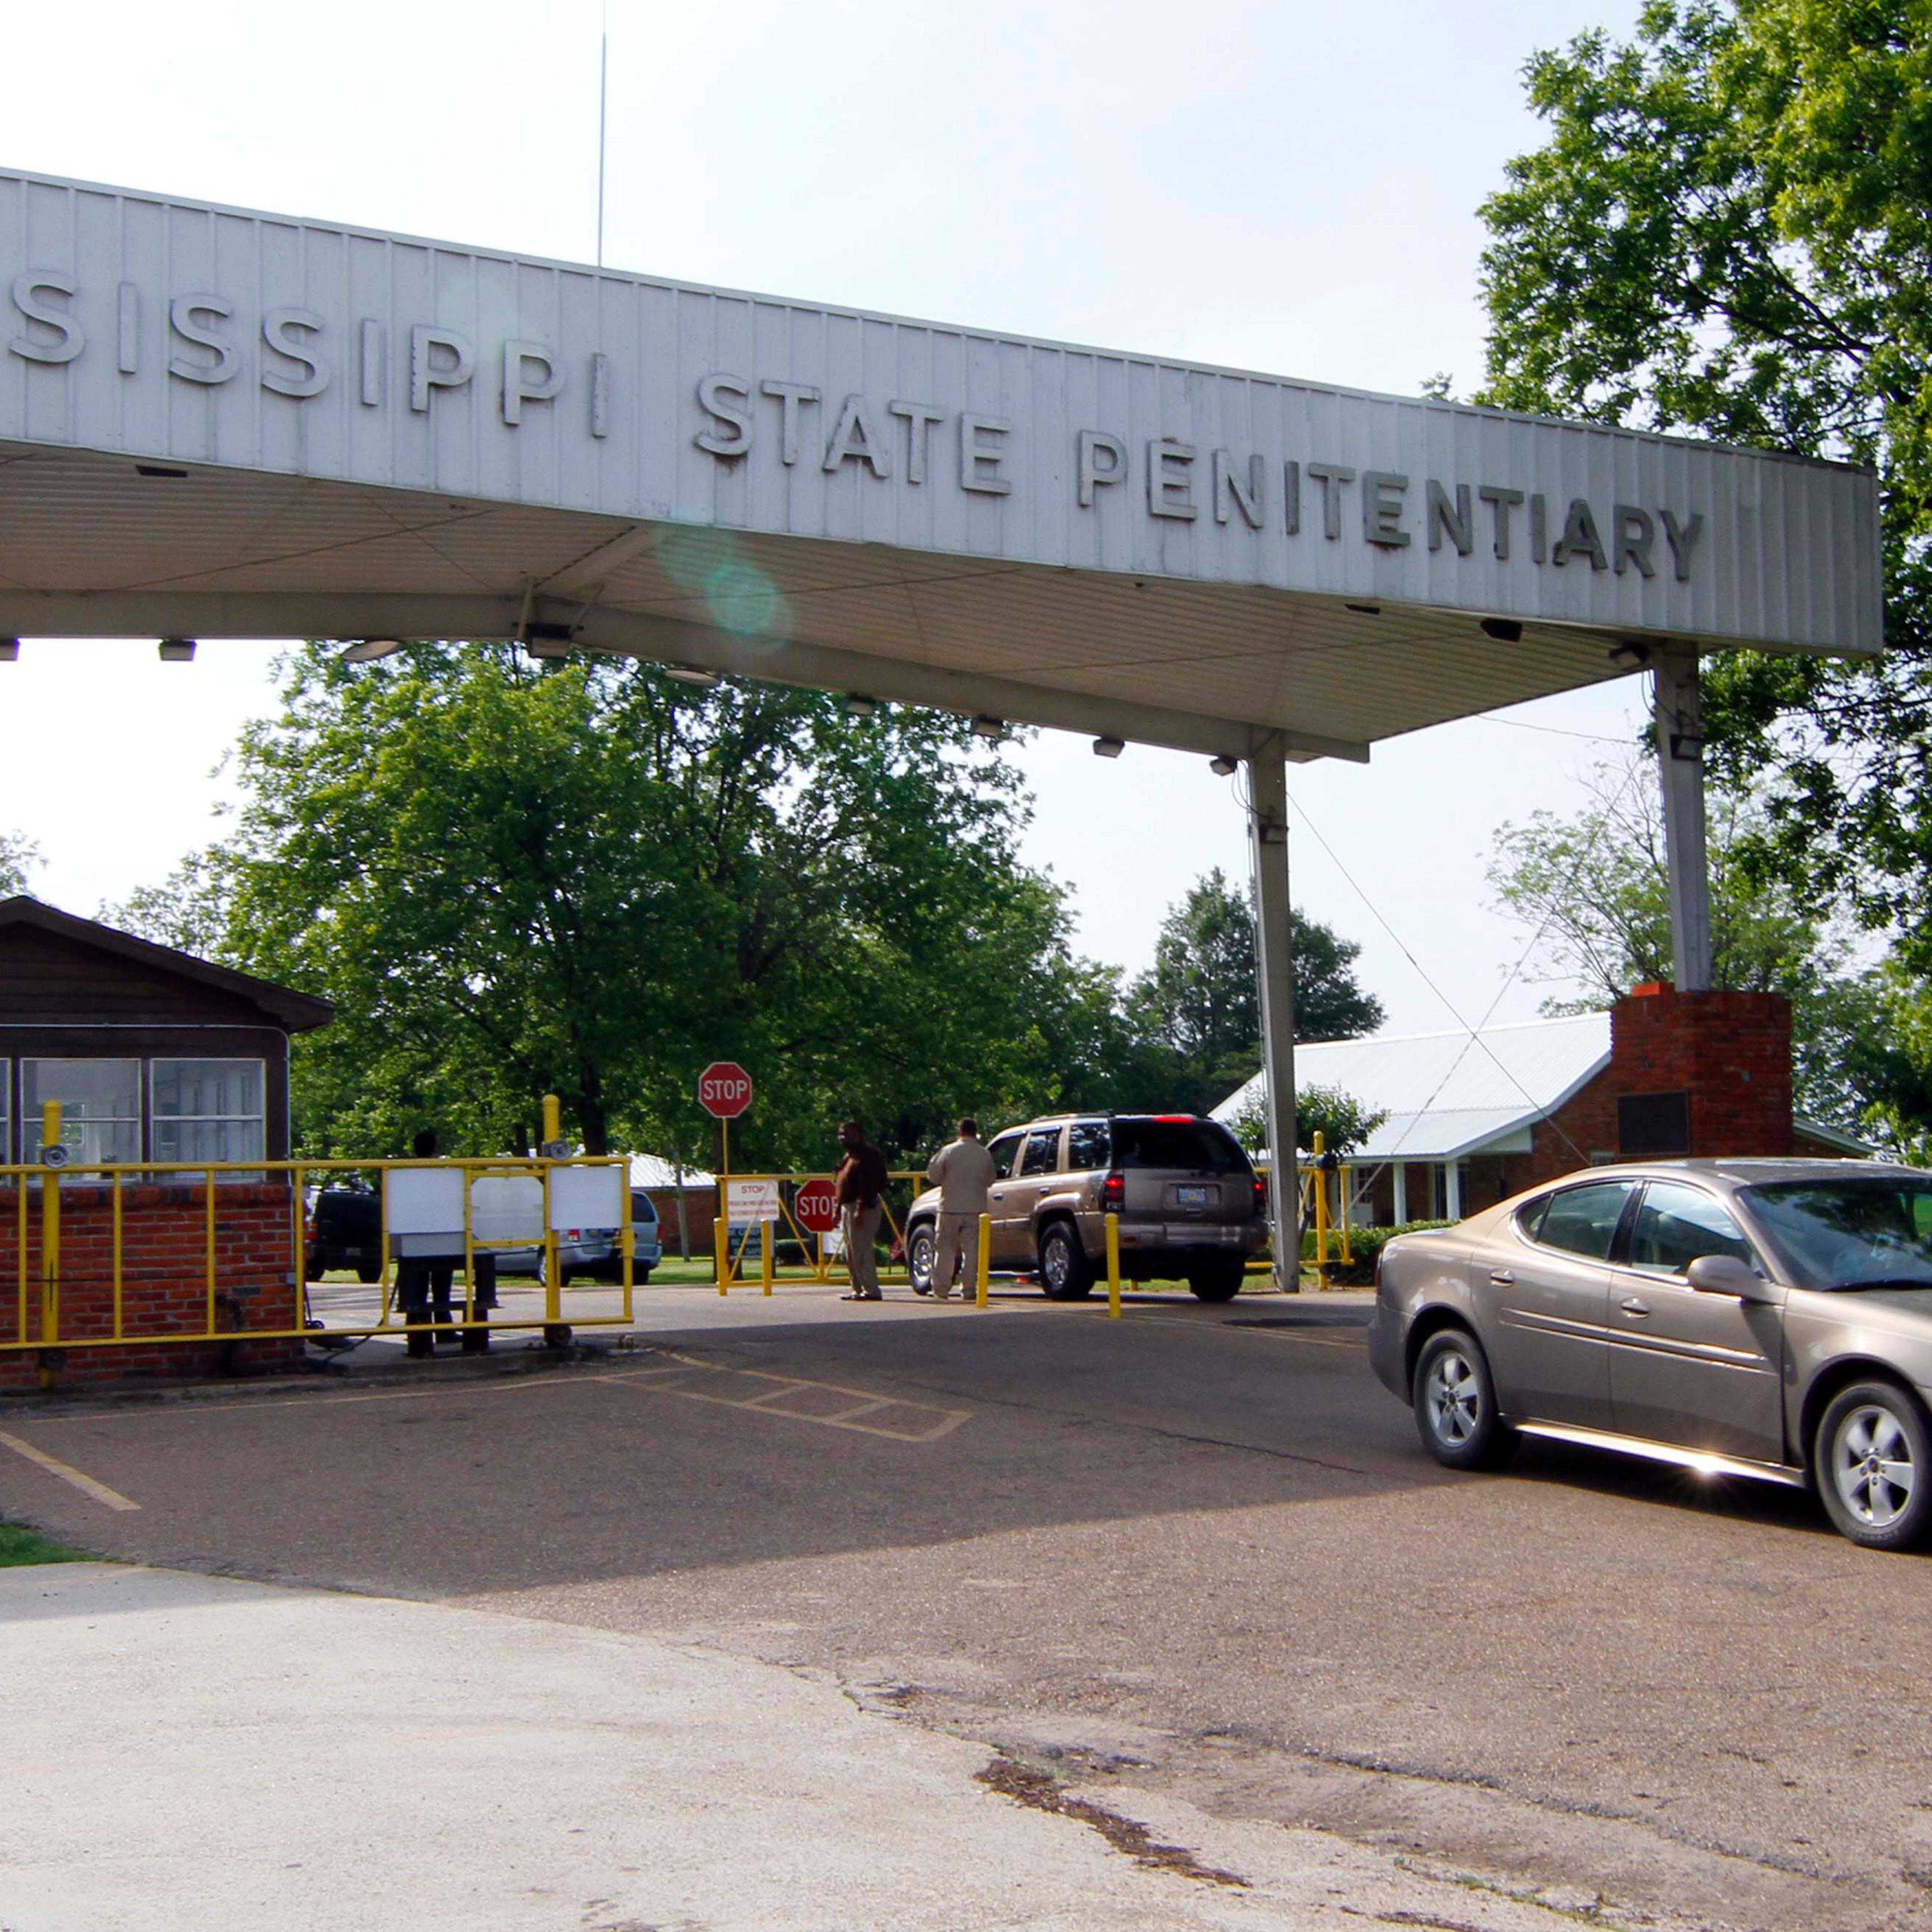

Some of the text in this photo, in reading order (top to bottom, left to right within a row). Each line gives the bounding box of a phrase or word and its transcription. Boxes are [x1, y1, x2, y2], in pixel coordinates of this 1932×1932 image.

[9, 269, 1705, 582] SISSIPPI STATE PENITENTIARY
[702, 1080, 748, 1100] STOP
[741, 1185, 765, 1194] STOP
